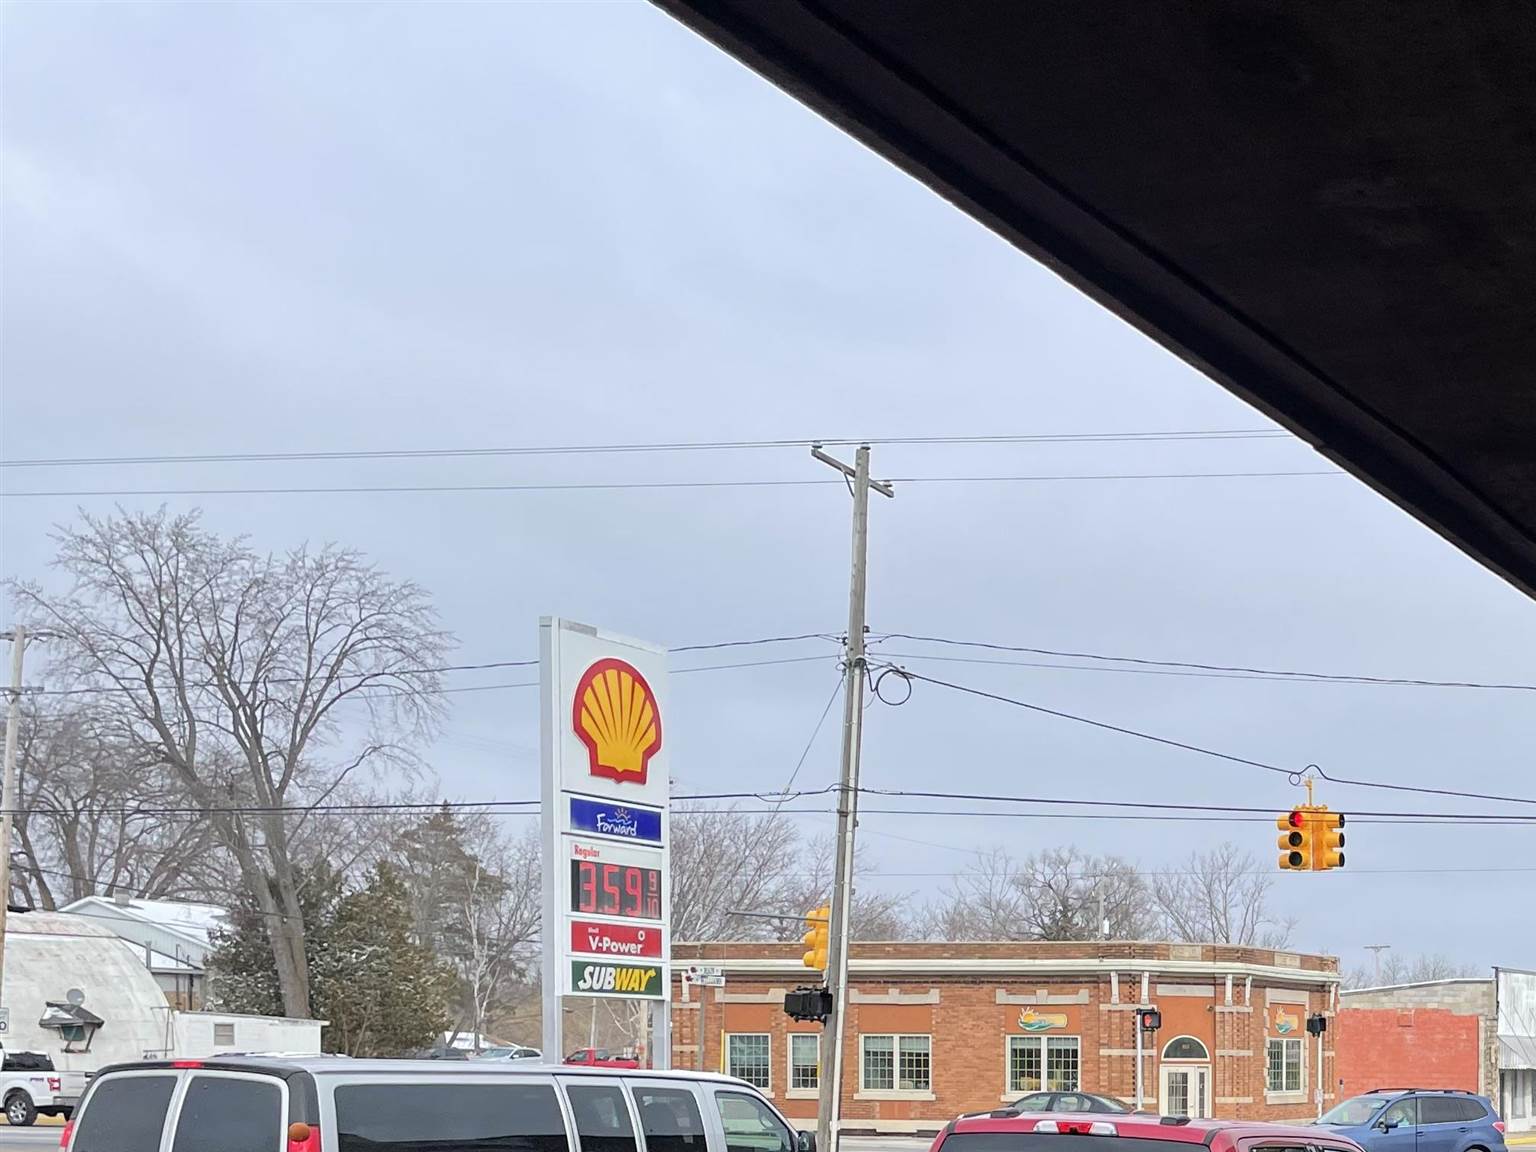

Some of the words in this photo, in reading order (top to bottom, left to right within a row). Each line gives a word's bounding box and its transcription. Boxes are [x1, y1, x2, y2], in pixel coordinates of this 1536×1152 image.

[596, 813, 638, 836] Forward
[588, 935, 644, 954] V-Power
[577, 965, 657, 992] SUBWAY
